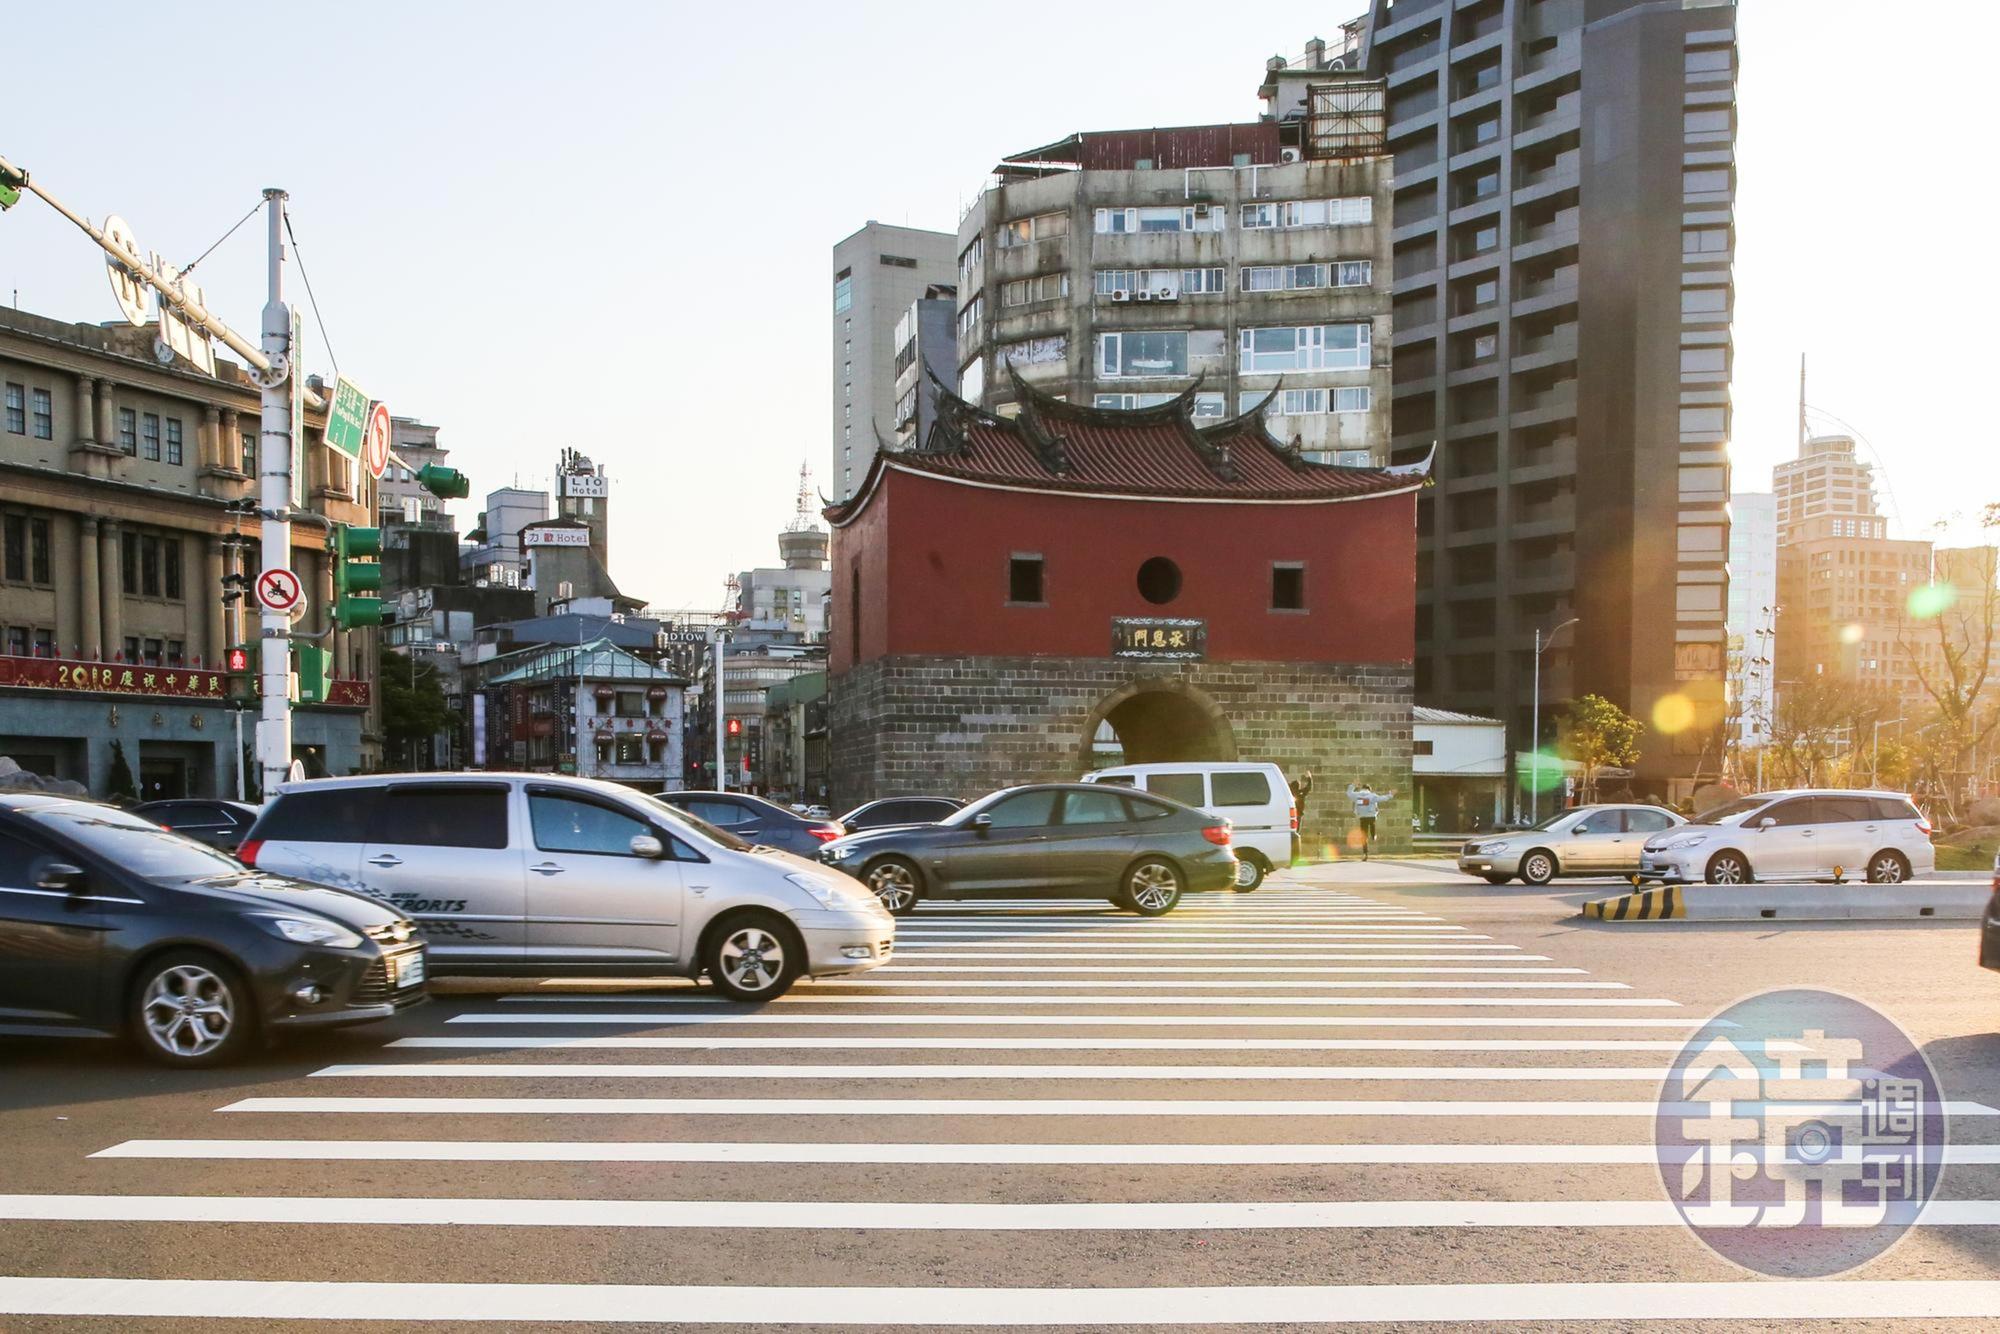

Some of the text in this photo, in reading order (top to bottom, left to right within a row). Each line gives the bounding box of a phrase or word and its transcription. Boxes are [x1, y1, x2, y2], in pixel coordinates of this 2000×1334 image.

[572, 478, 602, 486] LIO
[572, 487, 603, 495] Hotel
[557, 534, 587, 542] Hotel
